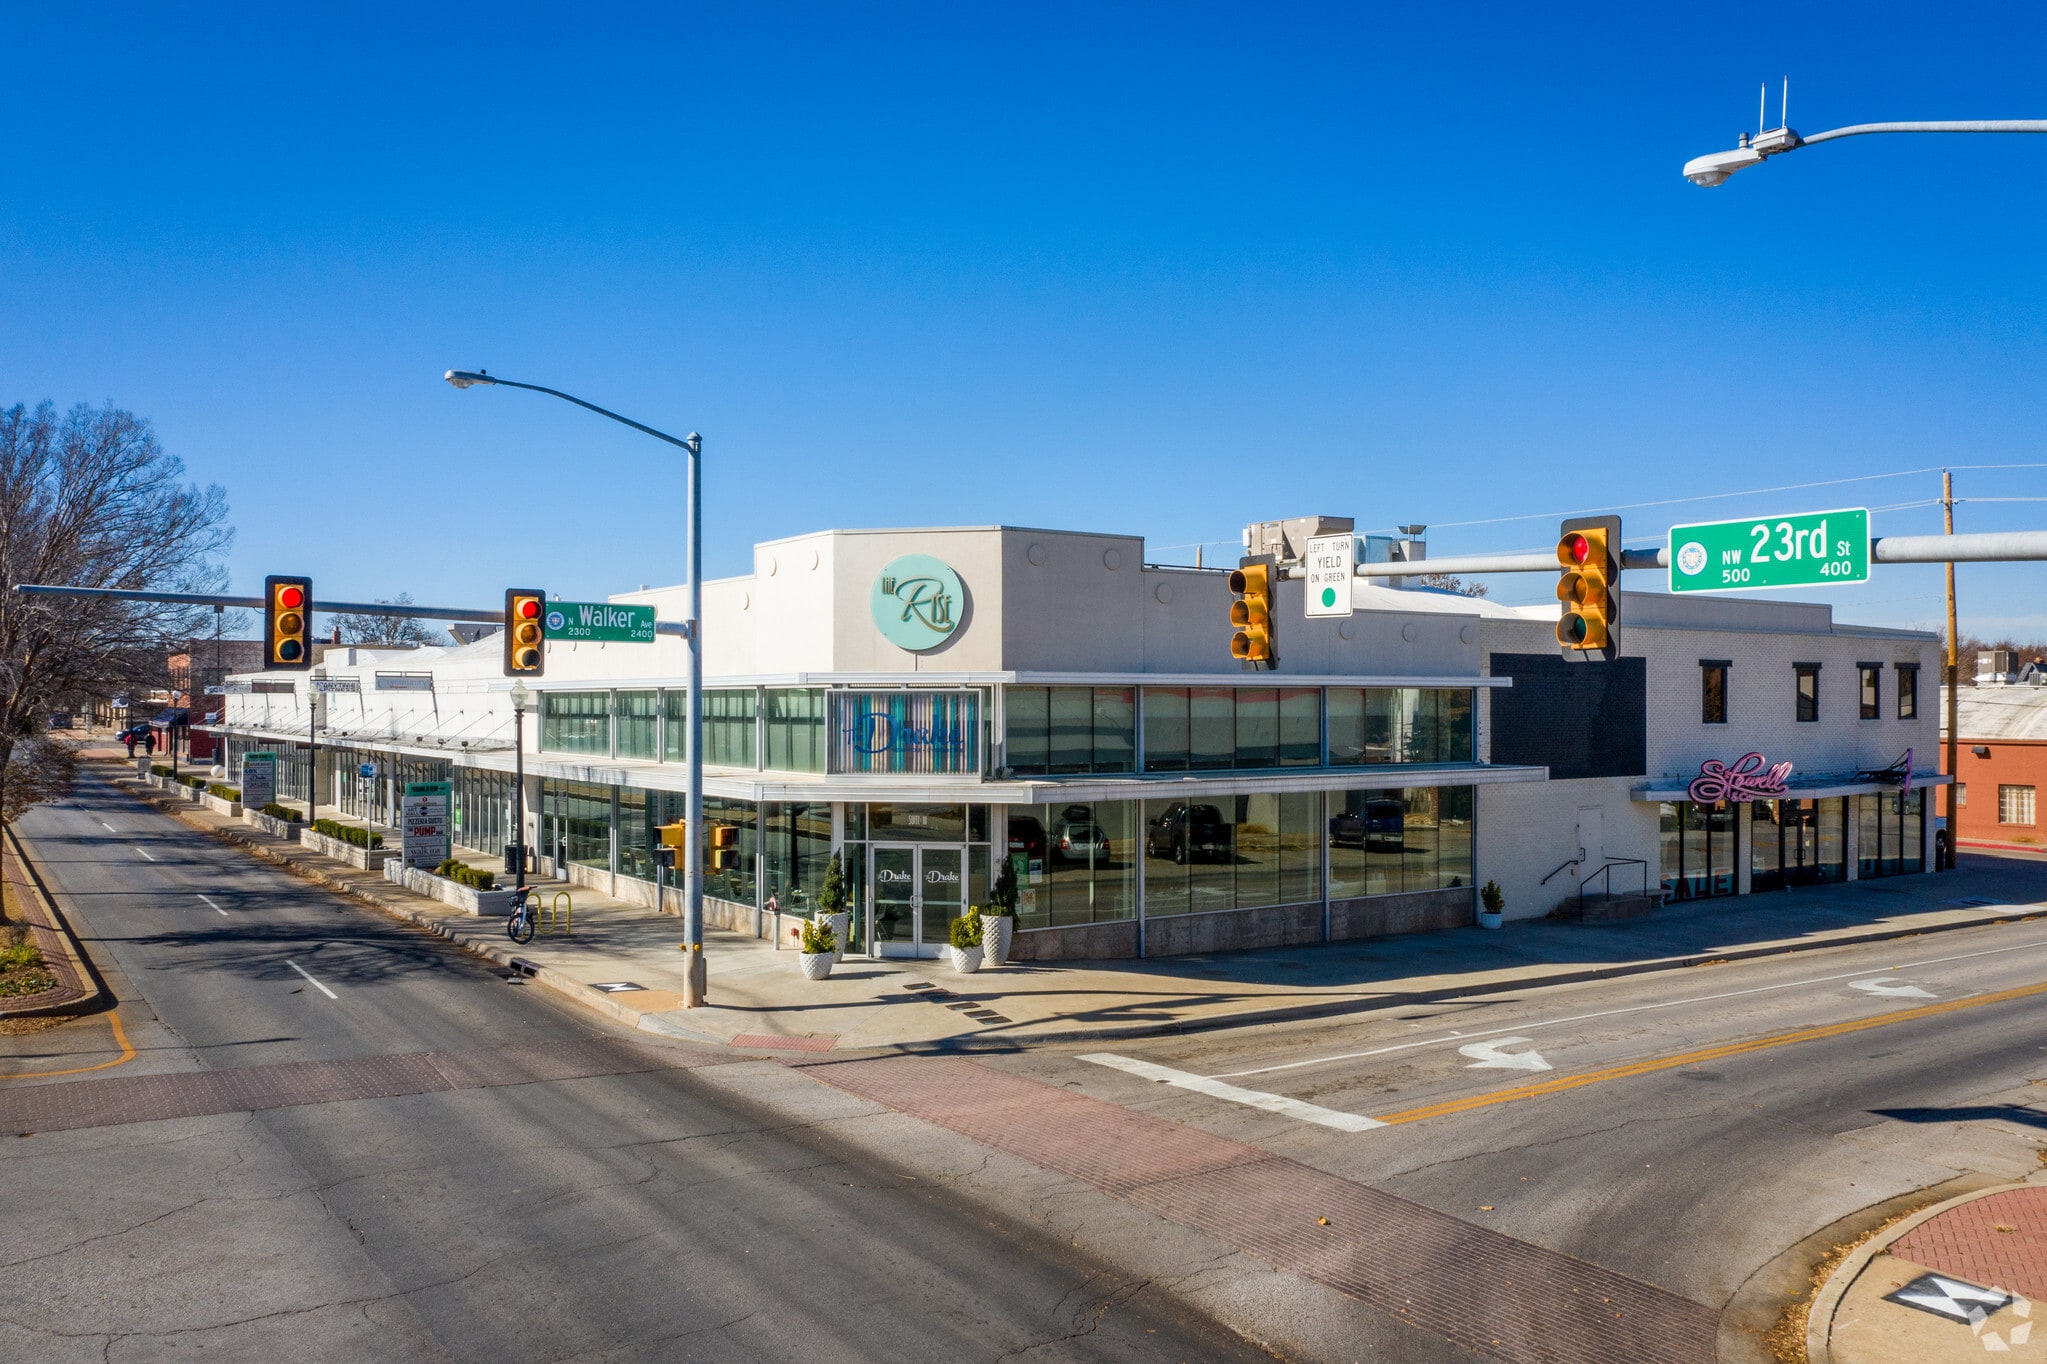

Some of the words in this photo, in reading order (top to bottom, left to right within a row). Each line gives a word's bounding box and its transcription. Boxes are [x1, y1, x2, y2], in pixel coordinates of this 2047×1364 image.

[1310, 543, 1324, 553] LEFT
[1333, 541, 1350, 552] TURN
[1722, 550, 1741, 565] NW
[1750, 519, 1827, 564] 23rd
[1837, 541, 1851, 557] St
[1318, 556, 1342, 569] YIELD
[1820, 561, 1852, 577] 400
[1311, 574, 1320, 583] ON
[1325, 572, 1345, 582] GREEN
[1722, 568, 1750, 583] 500
[568, 617, 574, 626] N
[579, 605, 636, 628] Walker
[640, 620, 653, 629] Ave
[568, 628, 591, 636] 2300
[630, 630, 653, 638] 2400
[854, 712, 964, 754] Drake
[414, 826, 436, 836] PUMP
[880, 869, 912, 882] Drake
[928, 870, 960, 883] Drake
[1660, 869, 1729, 900] SALE
